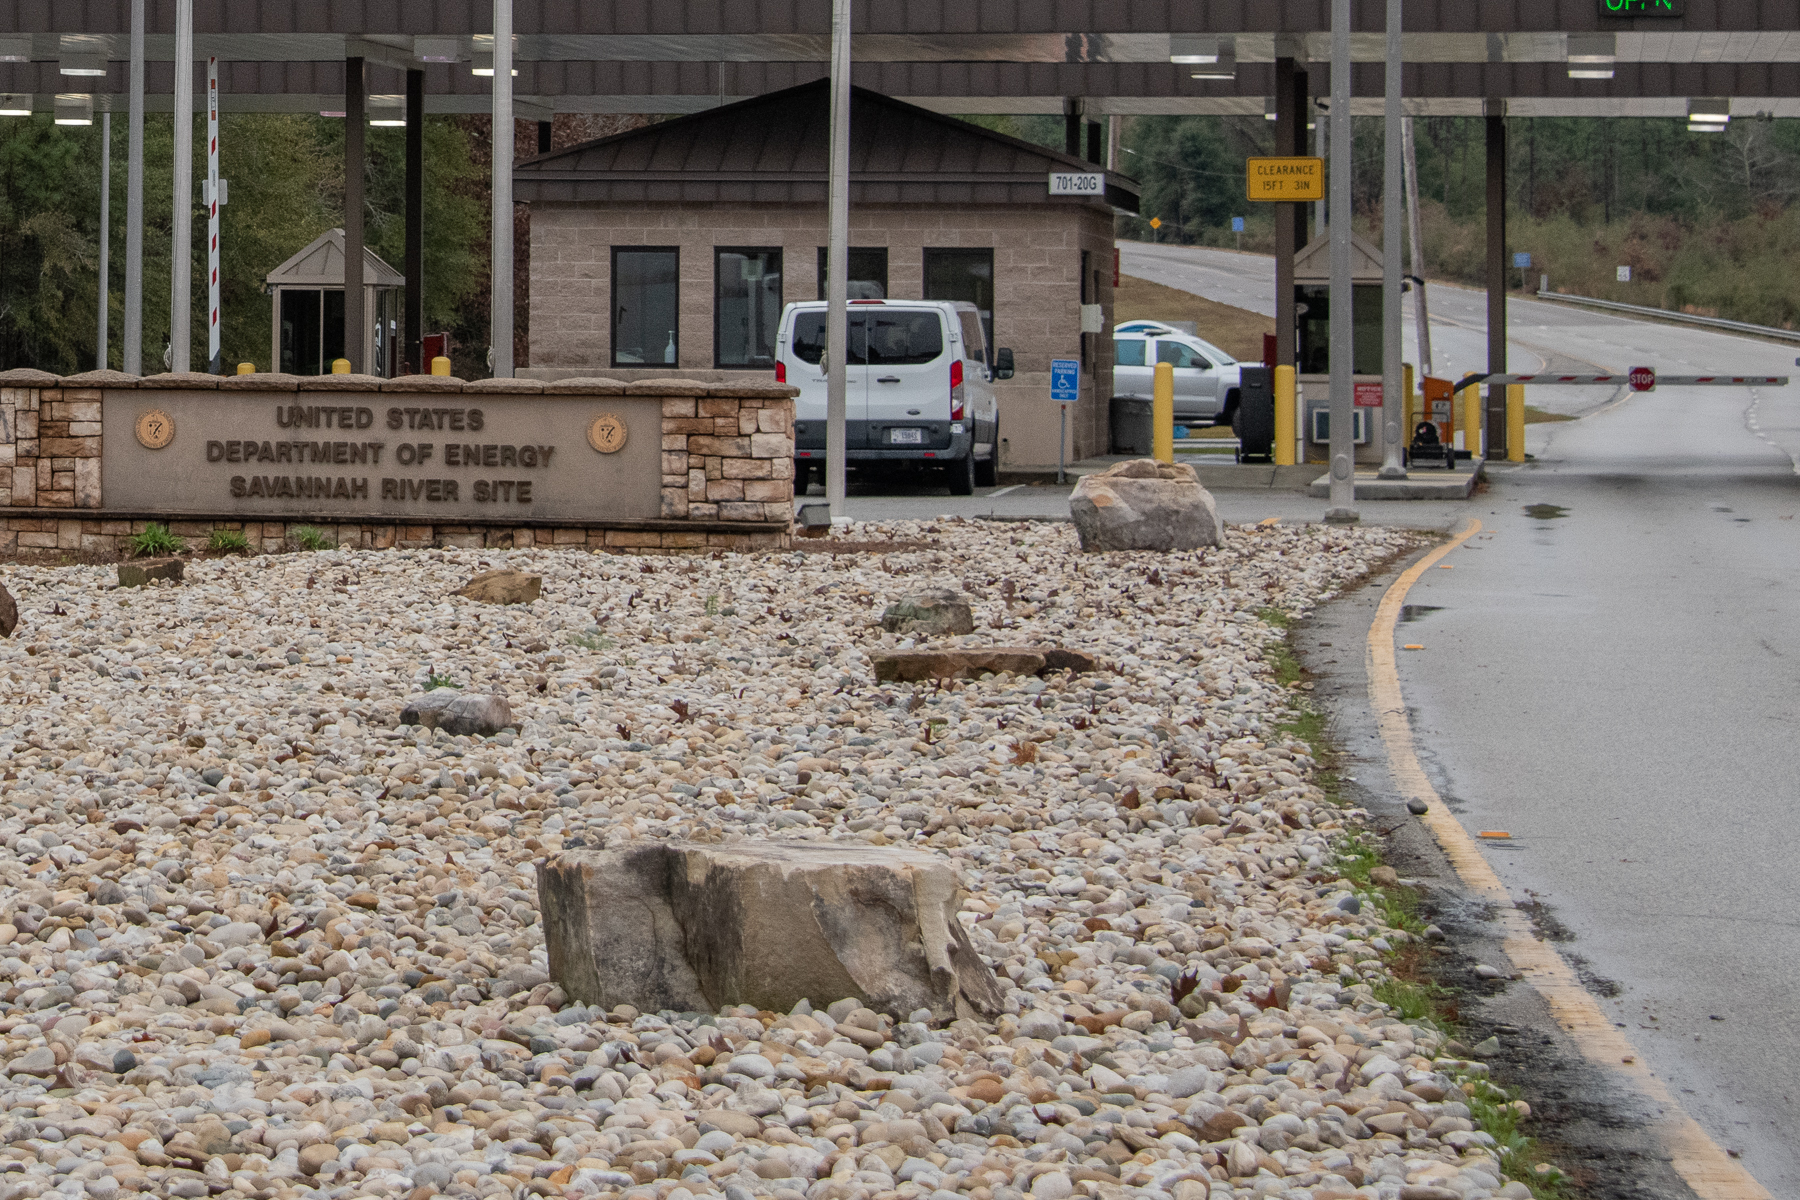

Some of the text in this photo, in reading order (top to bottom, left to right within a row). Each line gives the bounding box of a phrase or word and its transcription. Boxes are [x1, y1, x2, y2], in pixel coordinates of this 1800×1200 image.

[1257, 165, 1315, 176] CLEARANCE
[1056, 175, 1097, 190] 701-20G
[1263, 180, 1284, 191] 15FT
[1630, 373, 1654, 385] STOP
[276, 406, 485, 431] UNITED STATES
[205, 440, 555, 468] DEPARTMENT OF ENERGY
[229, 475, 533, 503] SAVANNAH RIVER SITE
